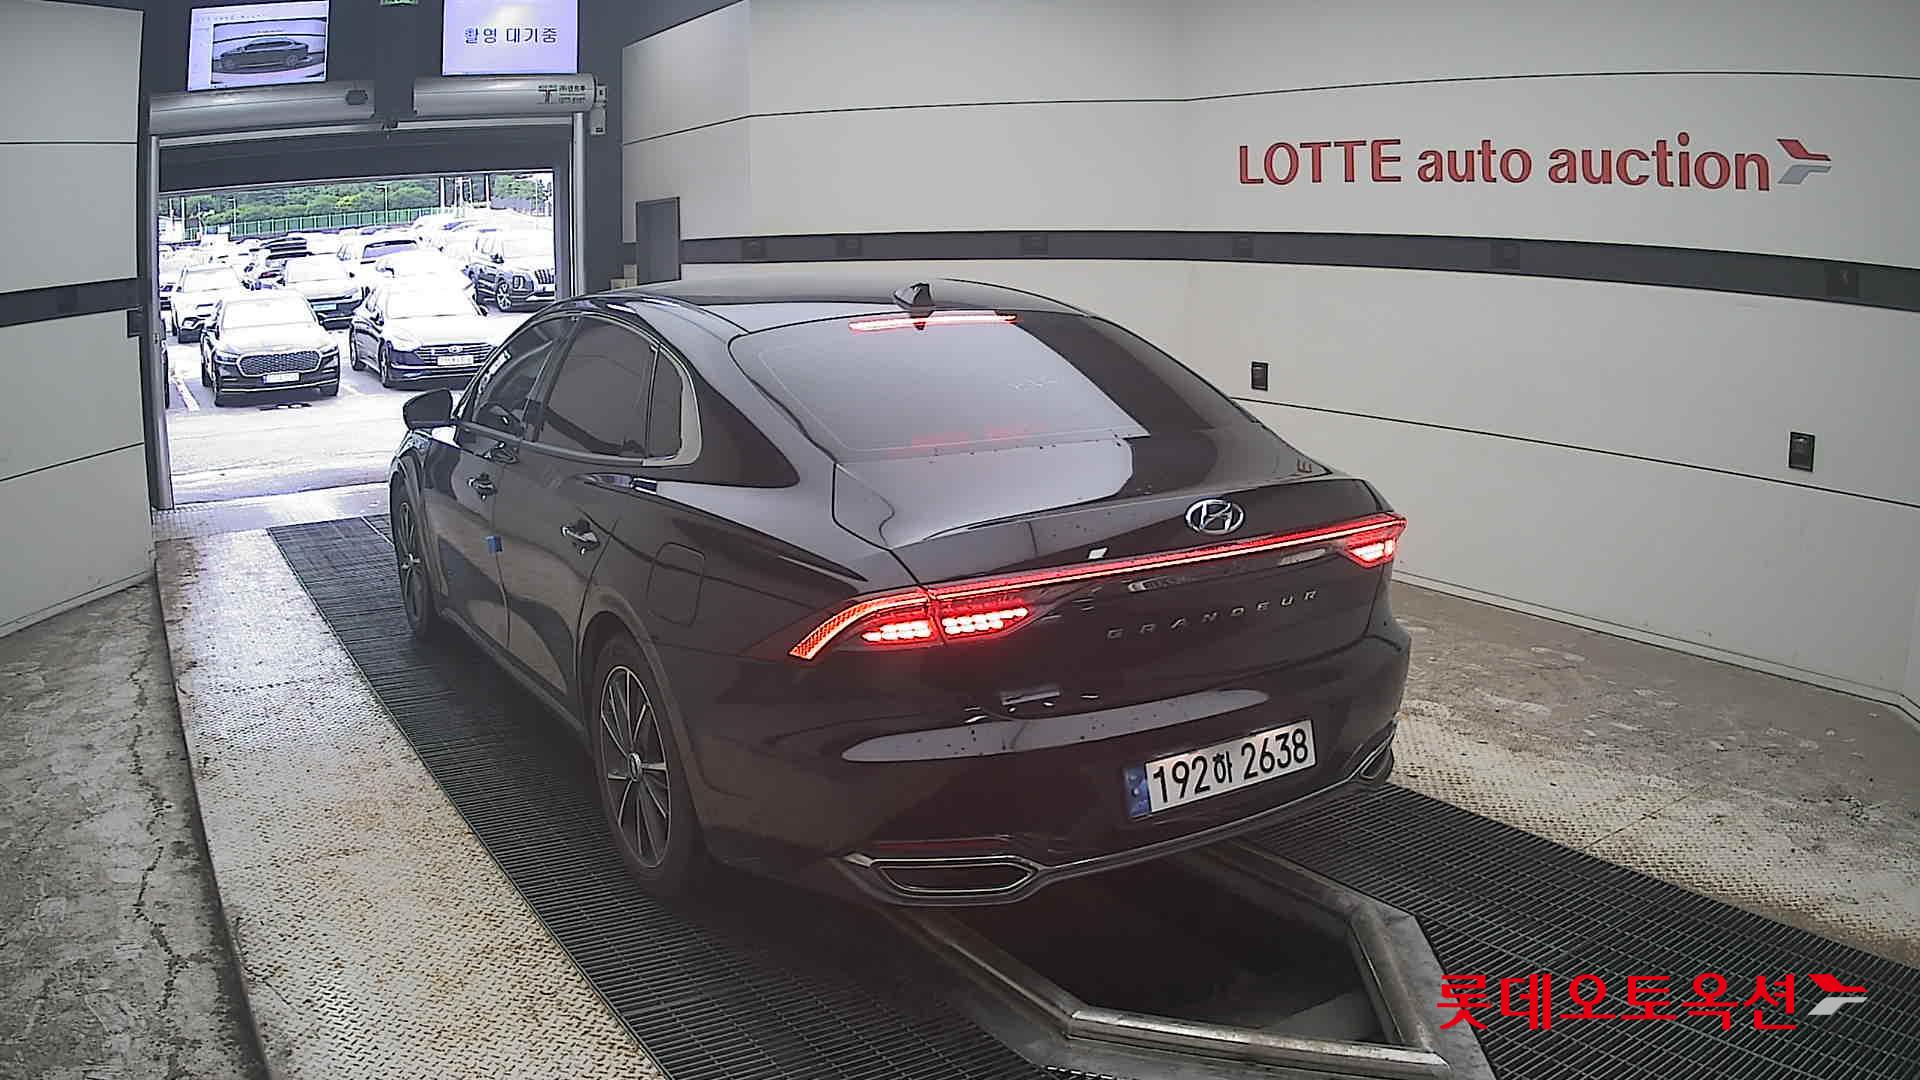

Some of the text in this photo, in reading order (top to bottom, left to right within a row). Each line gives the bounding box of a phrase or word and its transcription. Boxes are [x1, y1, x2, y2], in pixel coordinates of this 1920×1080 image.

[505, 27, 558, 44] 대기중
[1239, 132, 1770, 191] LOTTE auto auction
[1107, 590, 1317, 639] GRANDEUR
[1153, 728, 1308, 803] 192하 2638
